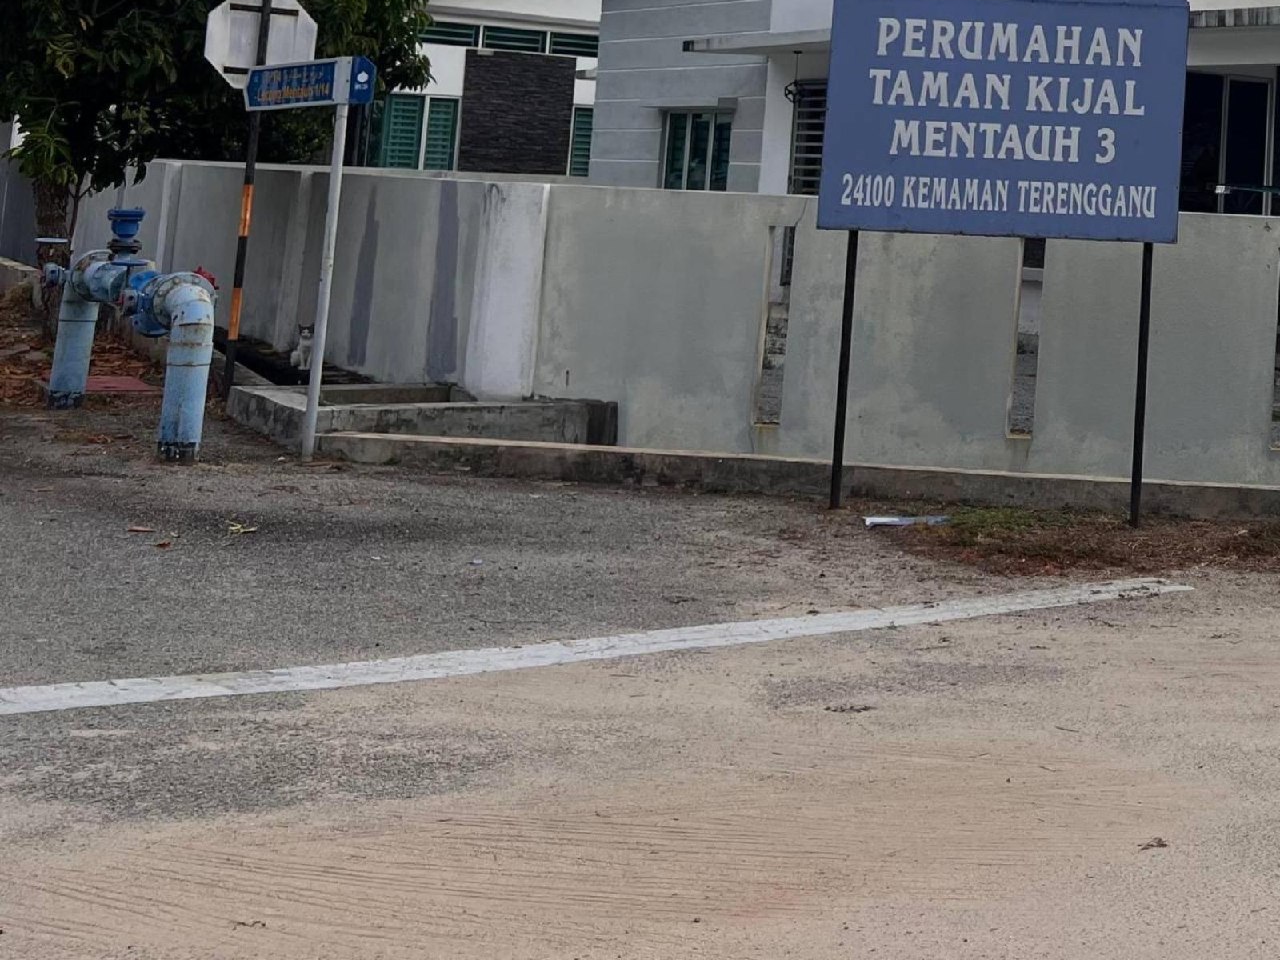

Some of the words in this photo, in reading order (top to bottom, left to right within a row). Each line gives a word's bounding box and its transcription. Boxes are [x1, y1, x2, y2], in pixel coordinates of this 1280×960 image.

[876, 17, 1143, 67] PERUMAHAN
[869, 69, 1011, 111] TAMAN
[1025, 75, 1145, 116] KIJAL
[889, 119, 1081, 163] MENTAUH
[1095, 127, 1116, 164] 3
[840, 173, 895, 208] 24100
[902, 176, 1009, 212] KEMAMAN
[1017, 180, 1157, 219] TERENGGANU
